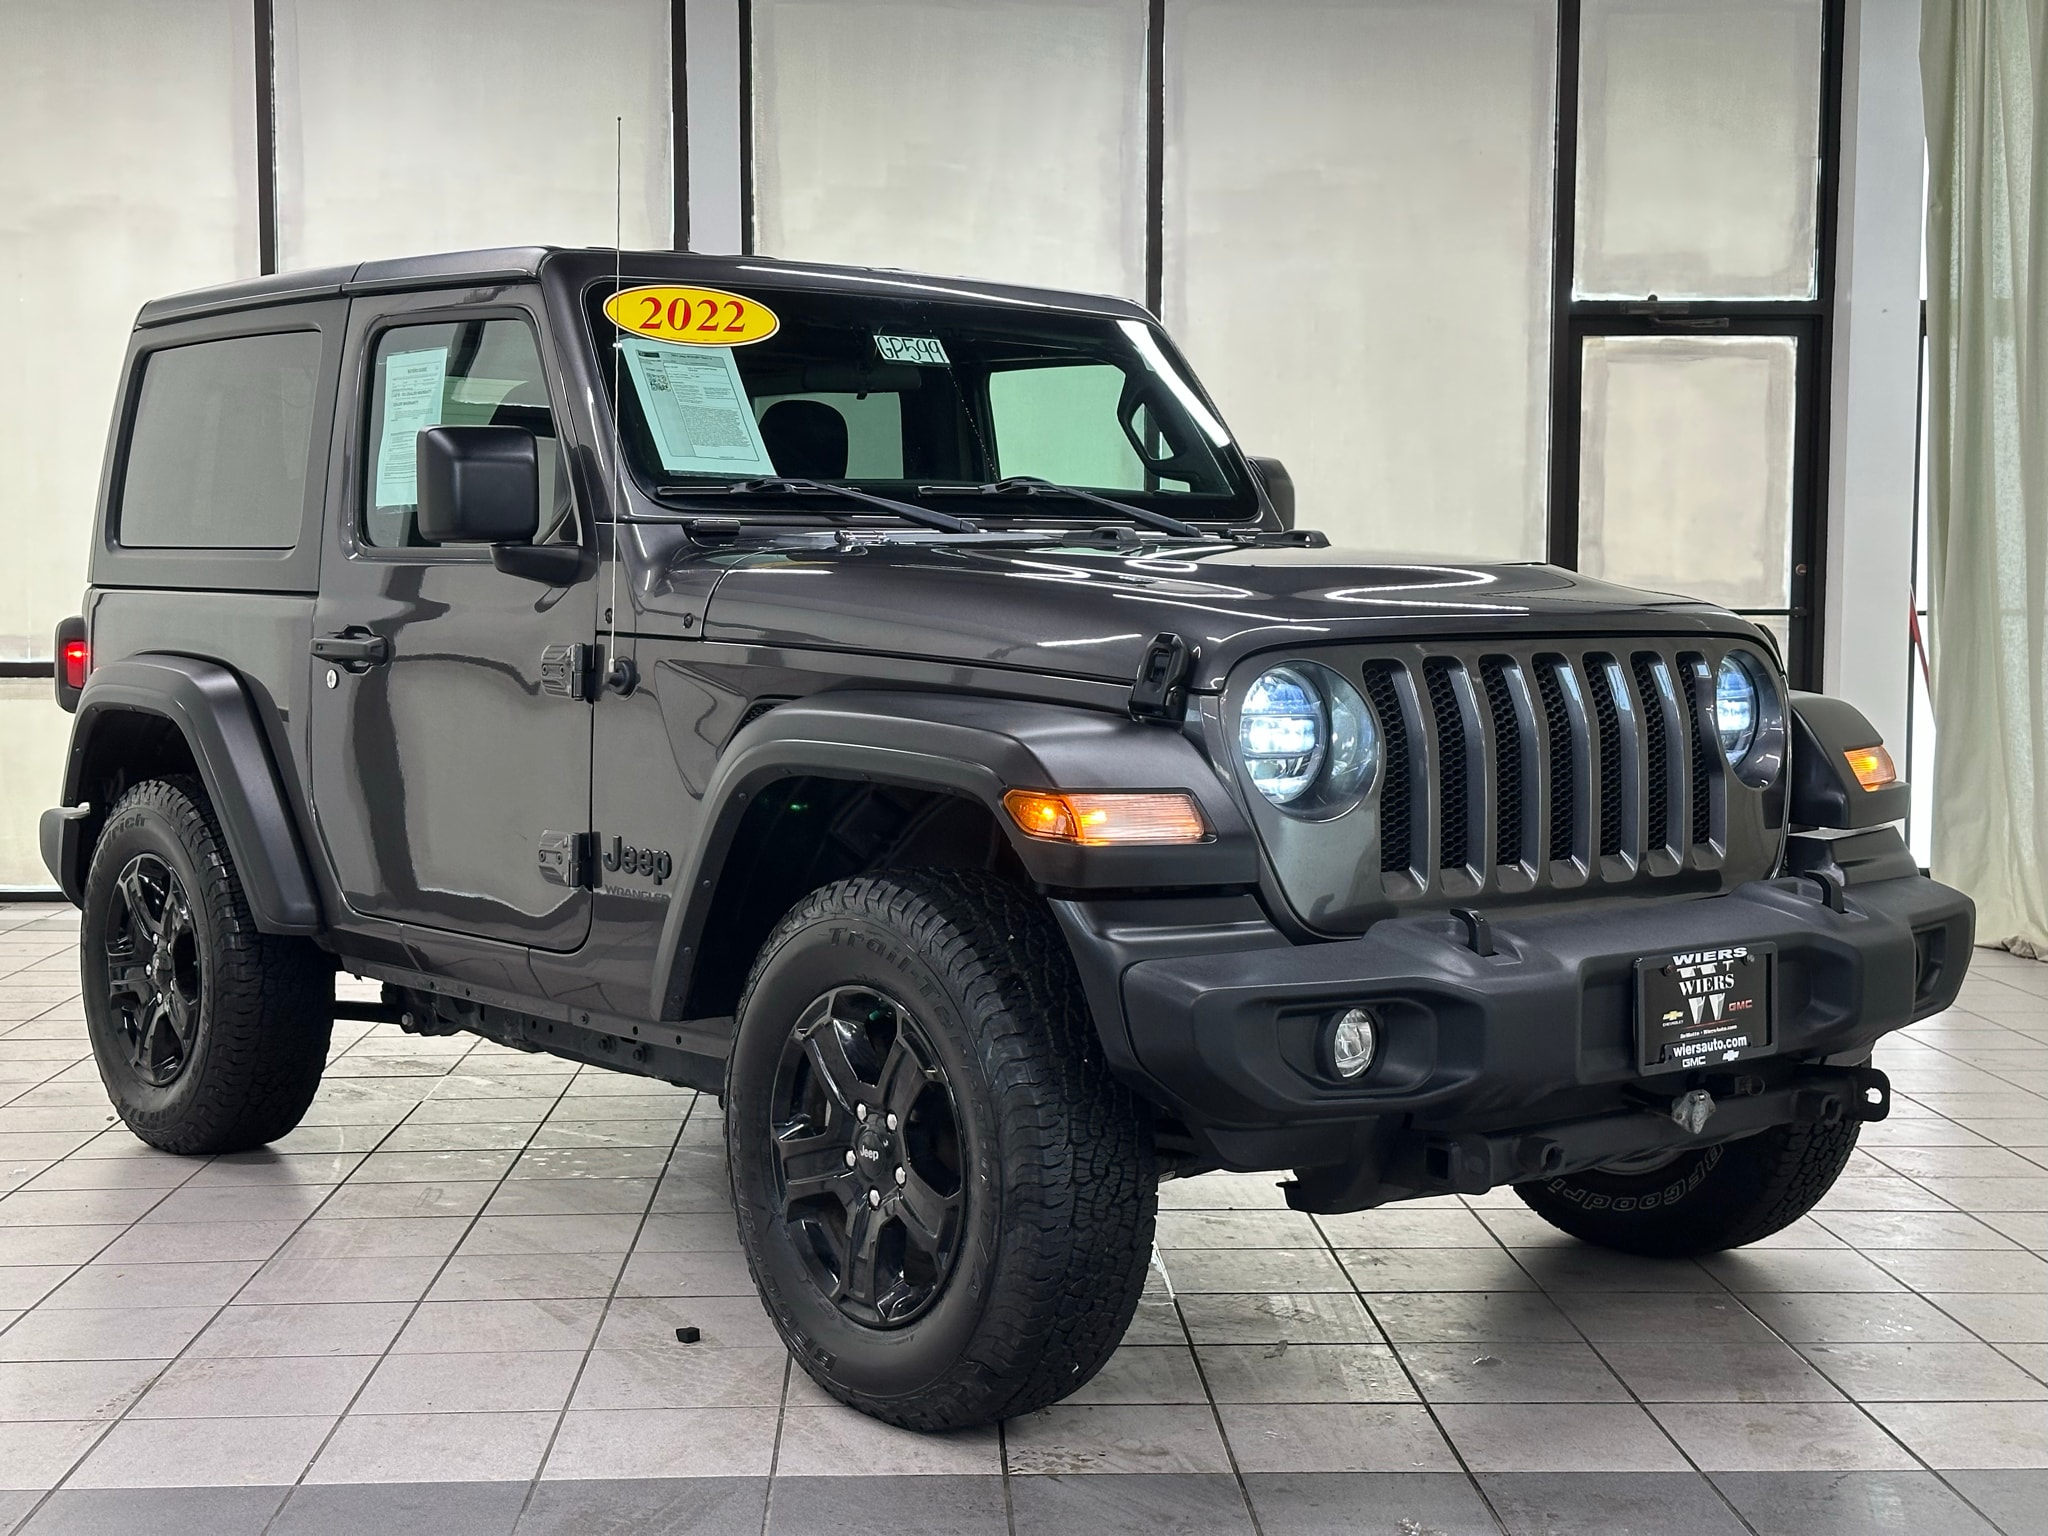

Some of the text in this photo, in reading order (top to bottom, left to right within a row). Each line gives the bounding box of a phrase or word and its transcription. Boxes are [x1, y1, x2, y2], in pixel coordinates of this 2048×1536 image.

[639, 296, 746, 332] 2022
[876, 336, 946, 363] GP599
[602, 835, 672, 886] Jeep
[1673, 947, 1748, 966] WIERS
[1678, 973, 1735, 996] WIERS
[1728, 999, 1753, 1012] GMC
[1672, 1035, 1748, 1058] wiersauto.com
[1682, 1055, 1706, 1068] GMC
[859, 1144, 880, 1162] Jeep
[1543, 1142, 1724, 1212] BFGoodri
